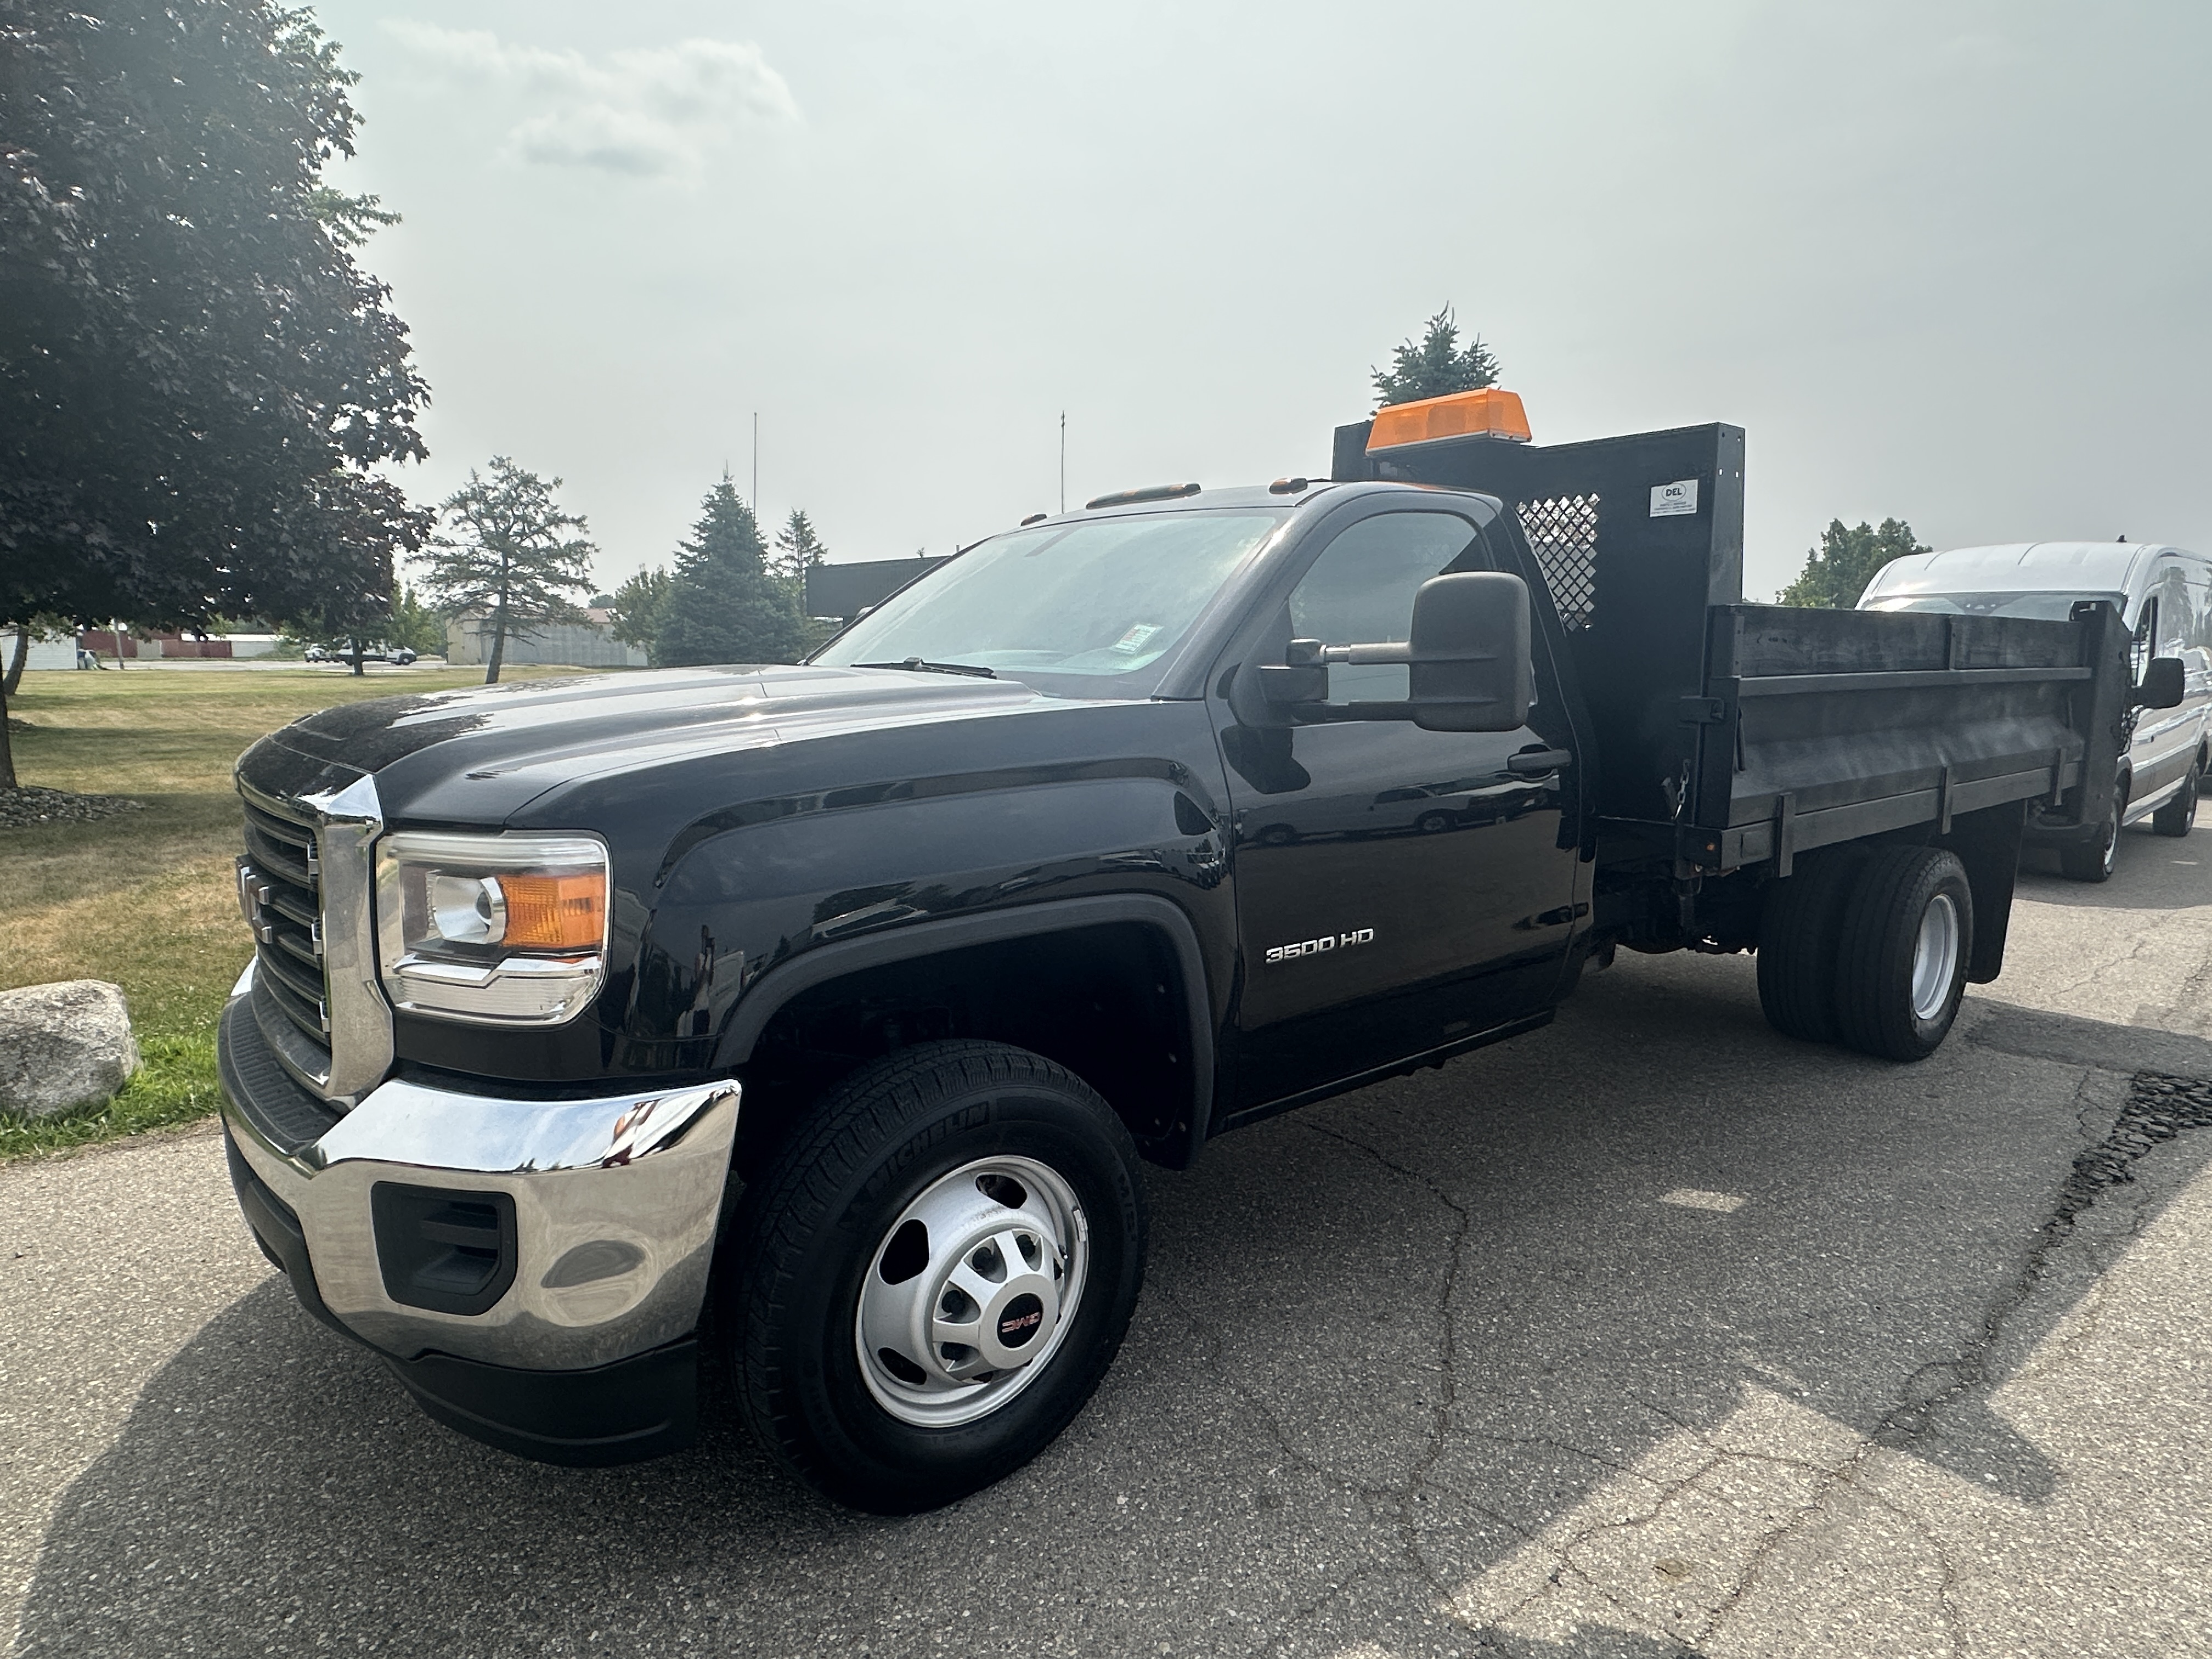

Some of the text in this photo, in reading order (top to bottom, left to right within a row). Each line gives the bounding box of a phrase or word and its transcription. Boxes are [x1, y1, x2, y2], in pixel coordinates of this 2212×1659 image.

[1666, 488, 1683, 496] DEL
[1265, 928, 1374, 963] 3500 HD
[865, 1102, 989, 1198] MICHELIN
[1002, 1312, 1040, 1333] GMC
